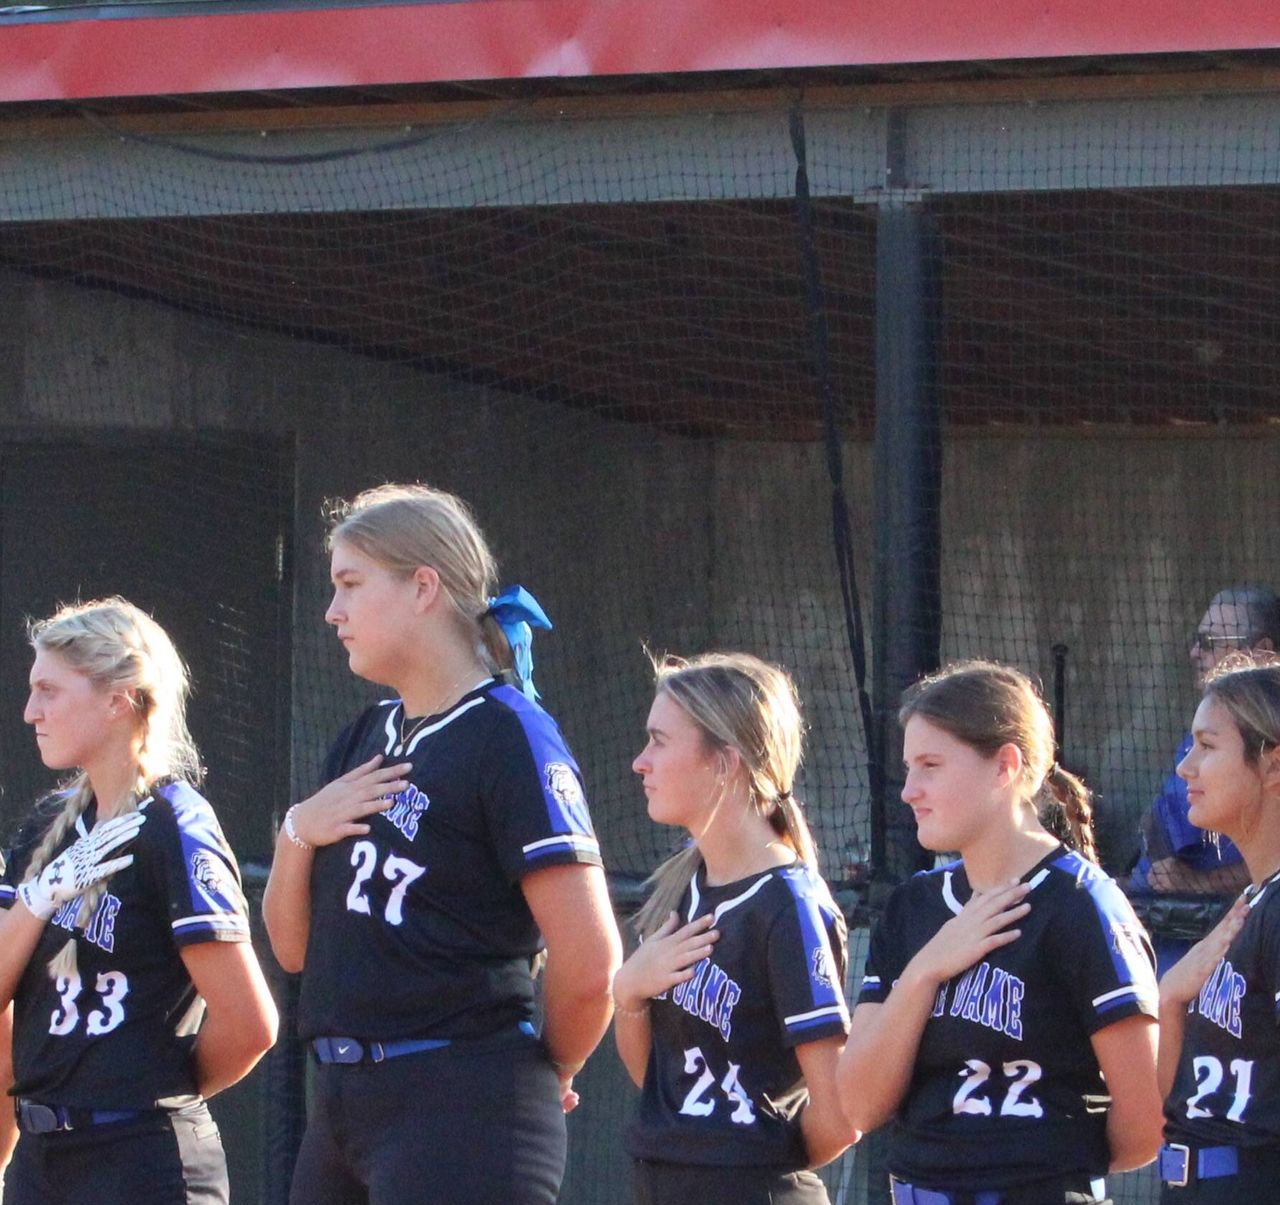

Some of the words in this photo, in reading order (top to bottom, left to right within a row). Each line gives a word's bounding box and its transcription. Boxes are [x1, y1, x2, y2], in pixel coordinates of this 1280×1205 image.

[347, 841, 426, 926] 27
[48, 971, 129, 1038] 33
[678, 1046, 756, 1124] 24
[952, 1059, 1044, 1118] 22
[1186, 1055, 1255, 1124] 21
